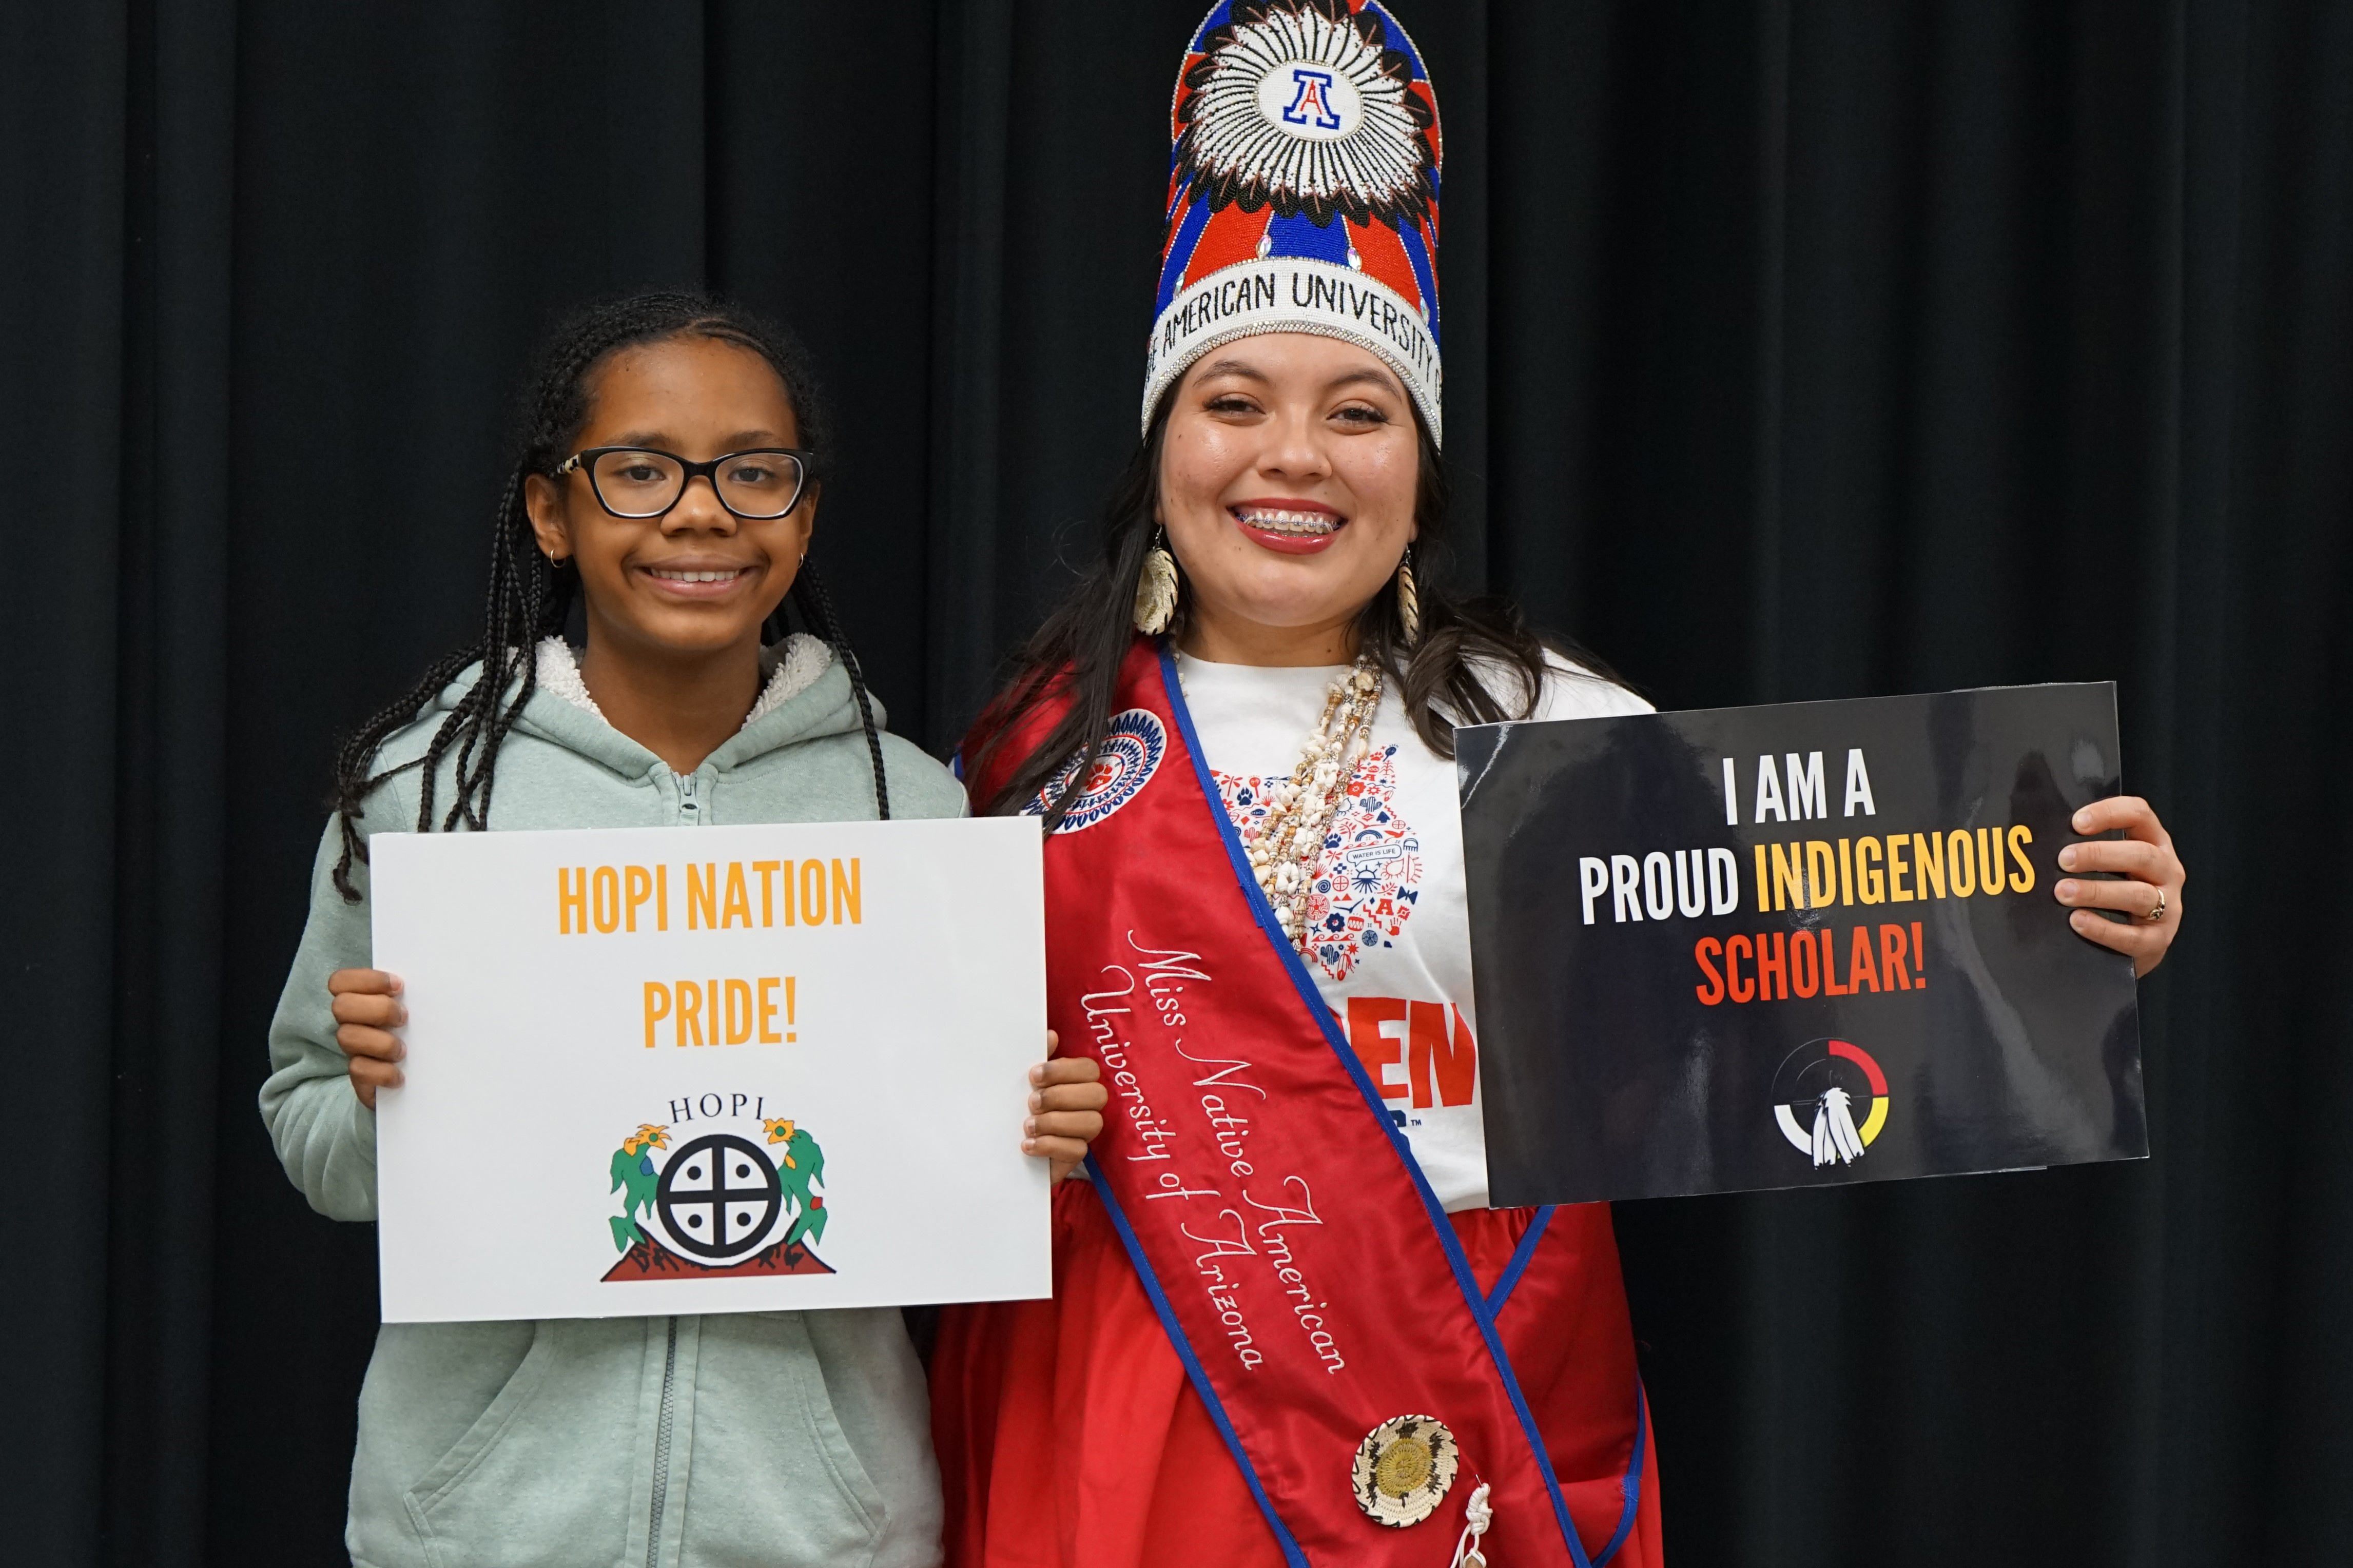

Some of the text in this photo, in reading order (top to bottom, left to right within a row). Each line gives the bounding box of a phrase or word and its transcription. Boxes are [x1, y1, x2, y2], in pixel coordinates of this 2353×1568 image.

[1283, 69, 1340, 130] A
[1163, 273, 1275, 357] AMERICAN
[1292, 272, 1432, 383] UNIVERSITY
[1723, 749, 1876, 826] I AM A
[558, 858, 862, 934] HOPI NATION
[1579, 825, 2036, 925] PROUD INDIGENOUS
[1695, 922, 1927, 1005] SCHOLAR!
[644, 977, 796, 1048] PRIDE!
[1326, 997, 1476, 1108] EN
[669, 1093, 764, 1124] HOPI
[1081, 965, 1265, 1371] University of Arizona
[1127, 930, 1346, 1375] Miss Native American
